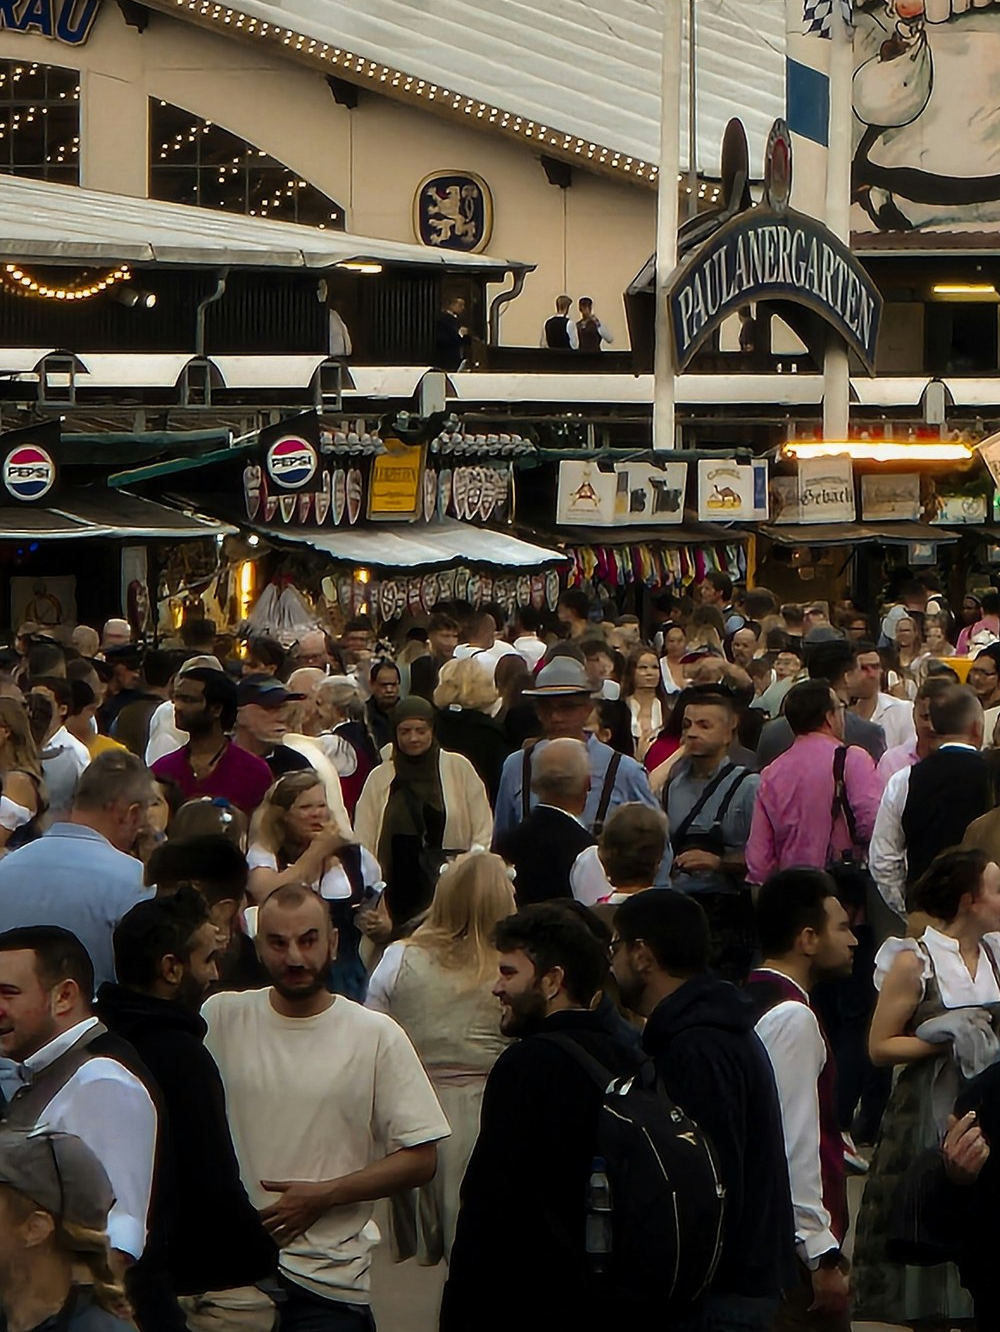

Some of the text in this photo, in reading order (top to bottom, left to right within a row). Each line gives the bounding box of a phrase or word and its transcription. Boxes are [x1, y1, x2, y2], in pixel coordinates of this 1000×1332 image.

[678, 225, 876, 350] PAULANERGARTEN
[271, 456, 312, 468] PEPSI
[8, 467, 50, 479] PEPSI
